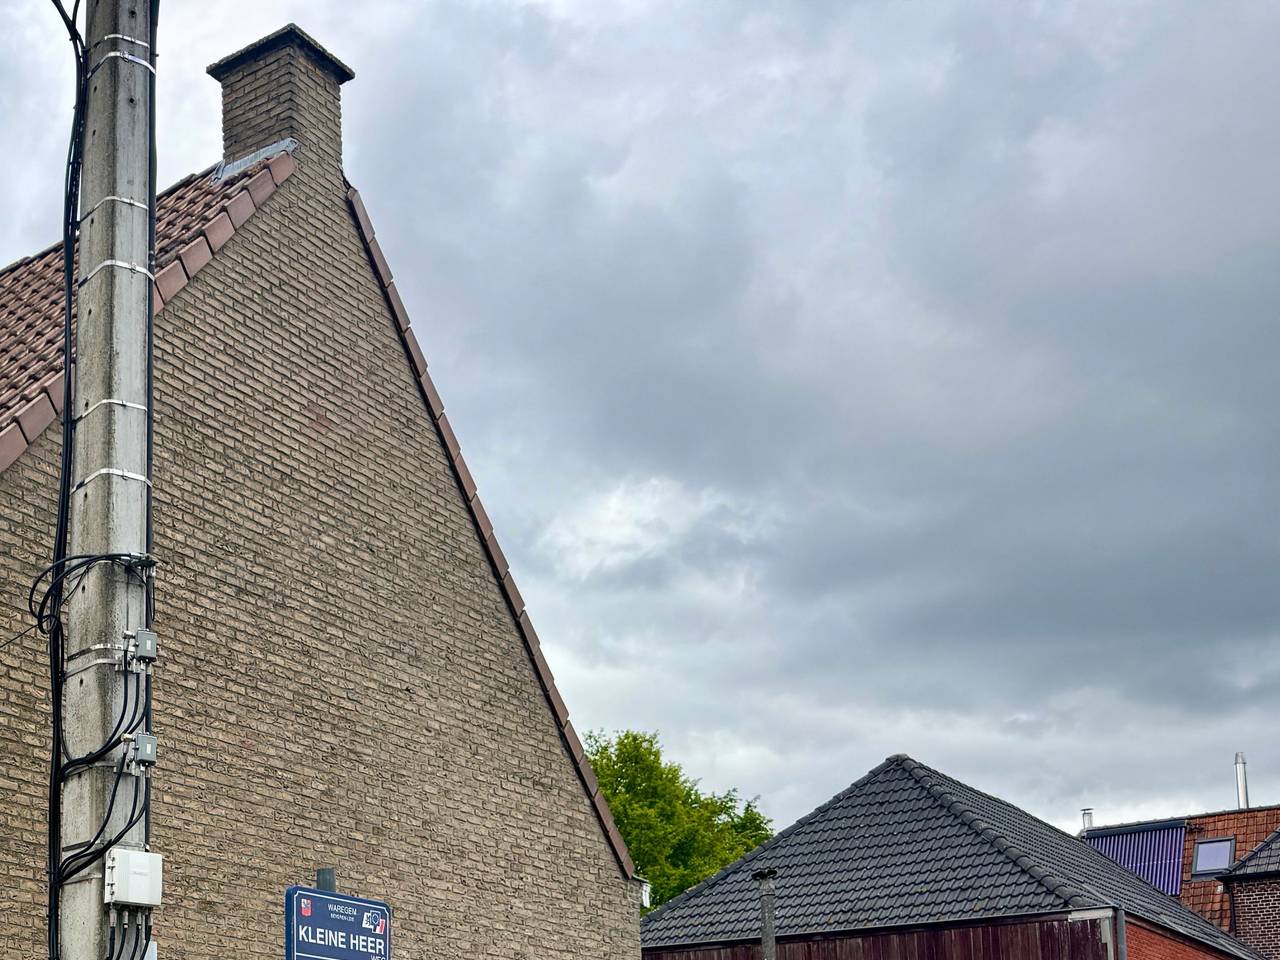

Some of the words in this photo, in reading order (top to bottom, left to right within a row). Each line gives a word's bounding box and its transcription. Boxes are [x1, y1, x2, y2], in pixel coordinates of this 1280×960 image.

[328, 904, 357, 915] WAREGEM
[299, 924, 346, 949] KLEINE
[350, 933, 385, 955] HEER
